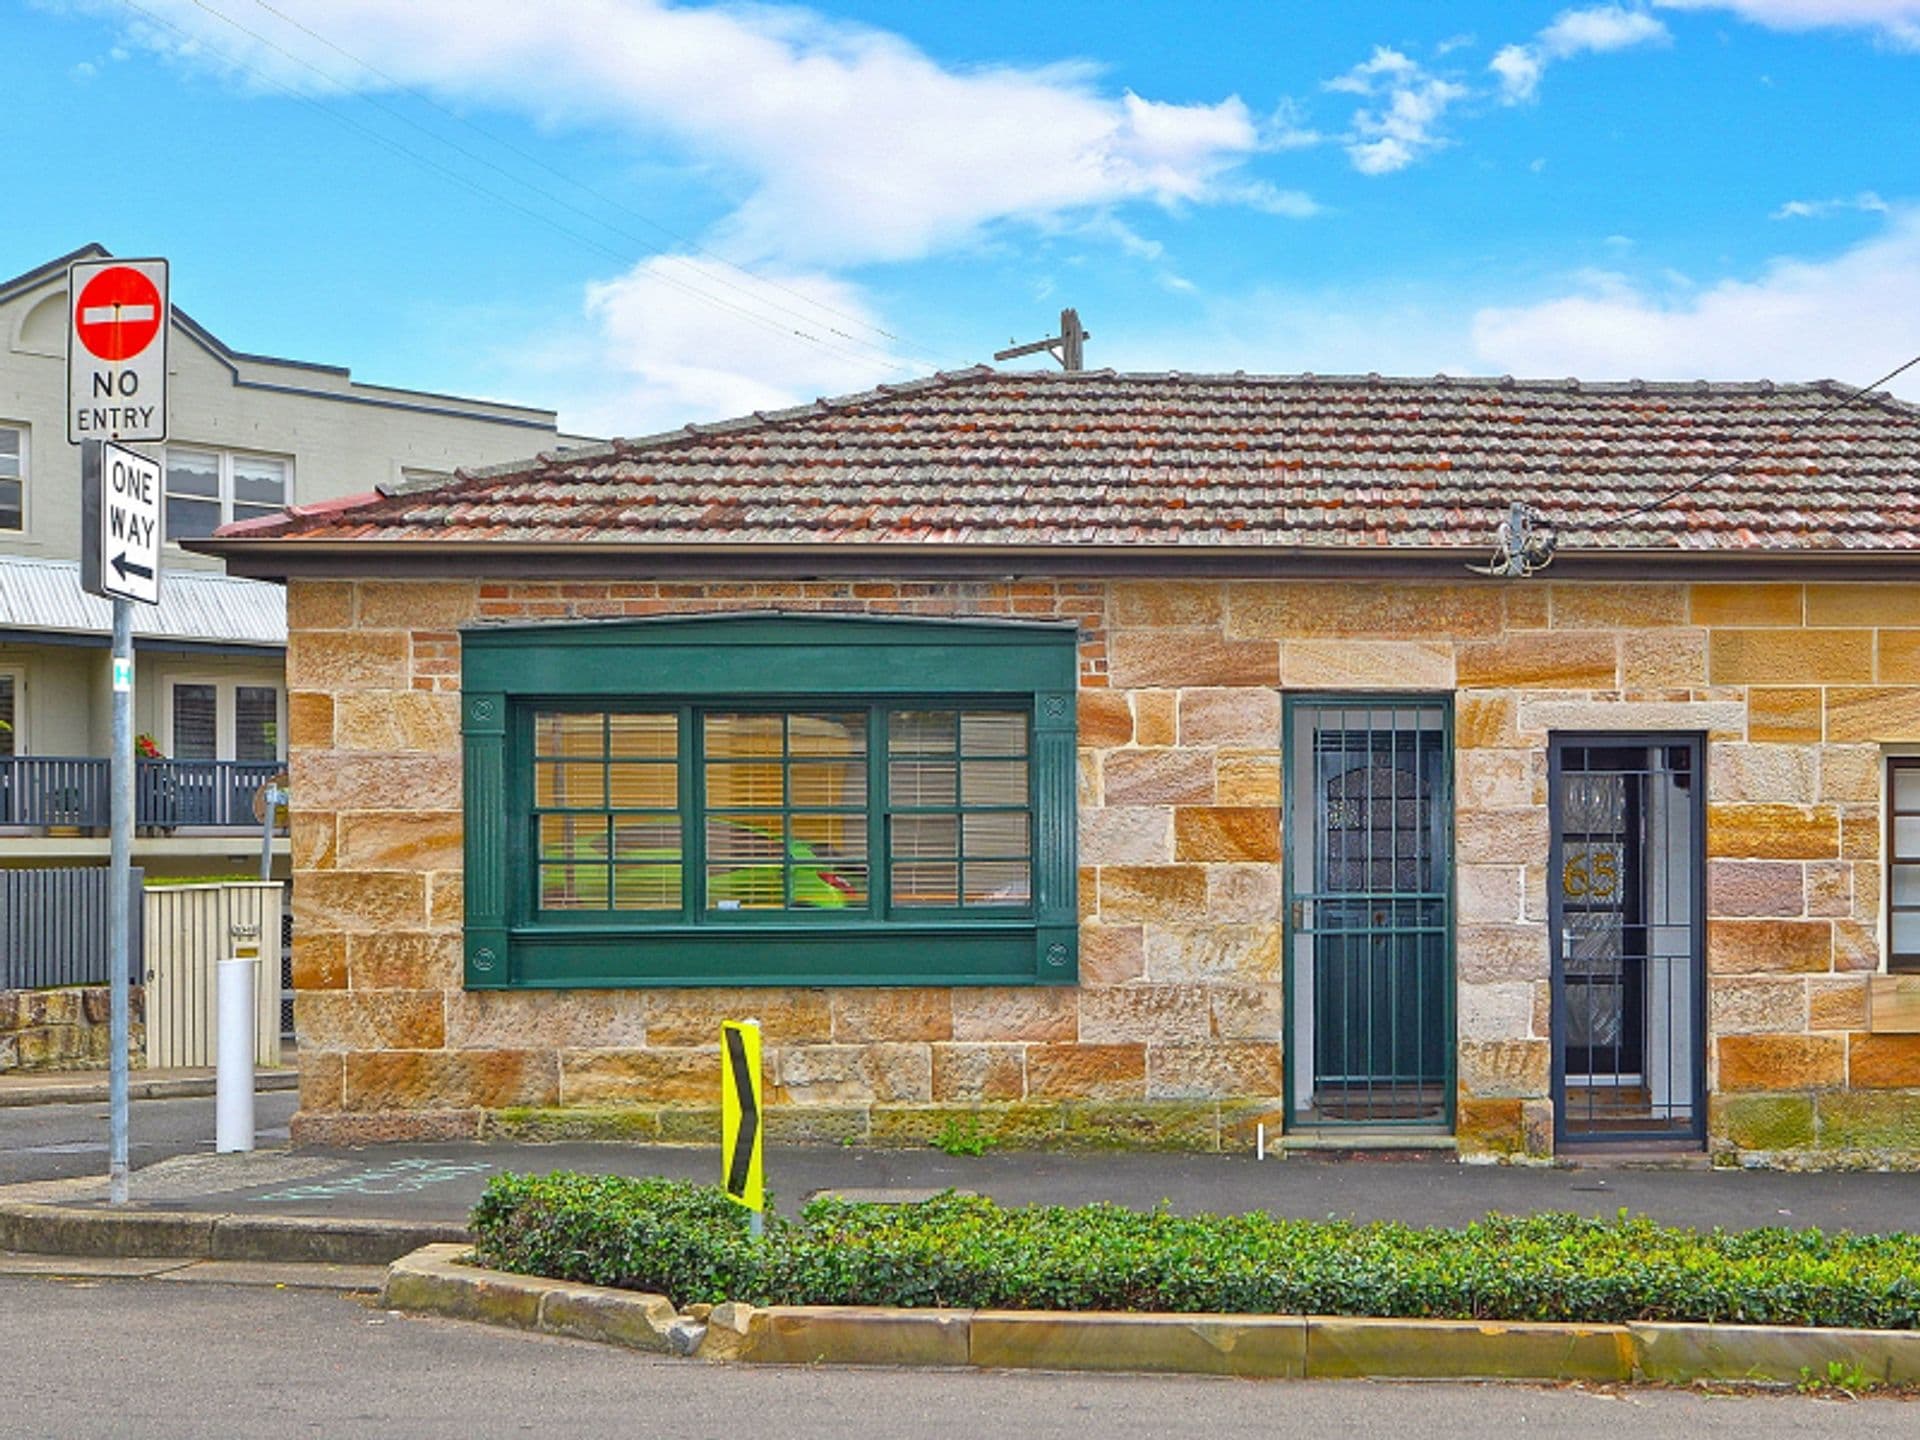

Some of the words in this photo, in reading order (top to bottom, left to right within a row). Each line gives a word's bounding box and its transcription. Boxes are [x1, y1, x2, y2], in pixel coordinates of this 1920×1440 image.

[93, 370, 138, 398] NO
[78, 406, 155, 430] ENTRY
[112, 460, 153, 505] ONE
[110, 504, 155, 549] WAY
[1563, 852, 1616, 896] 65
